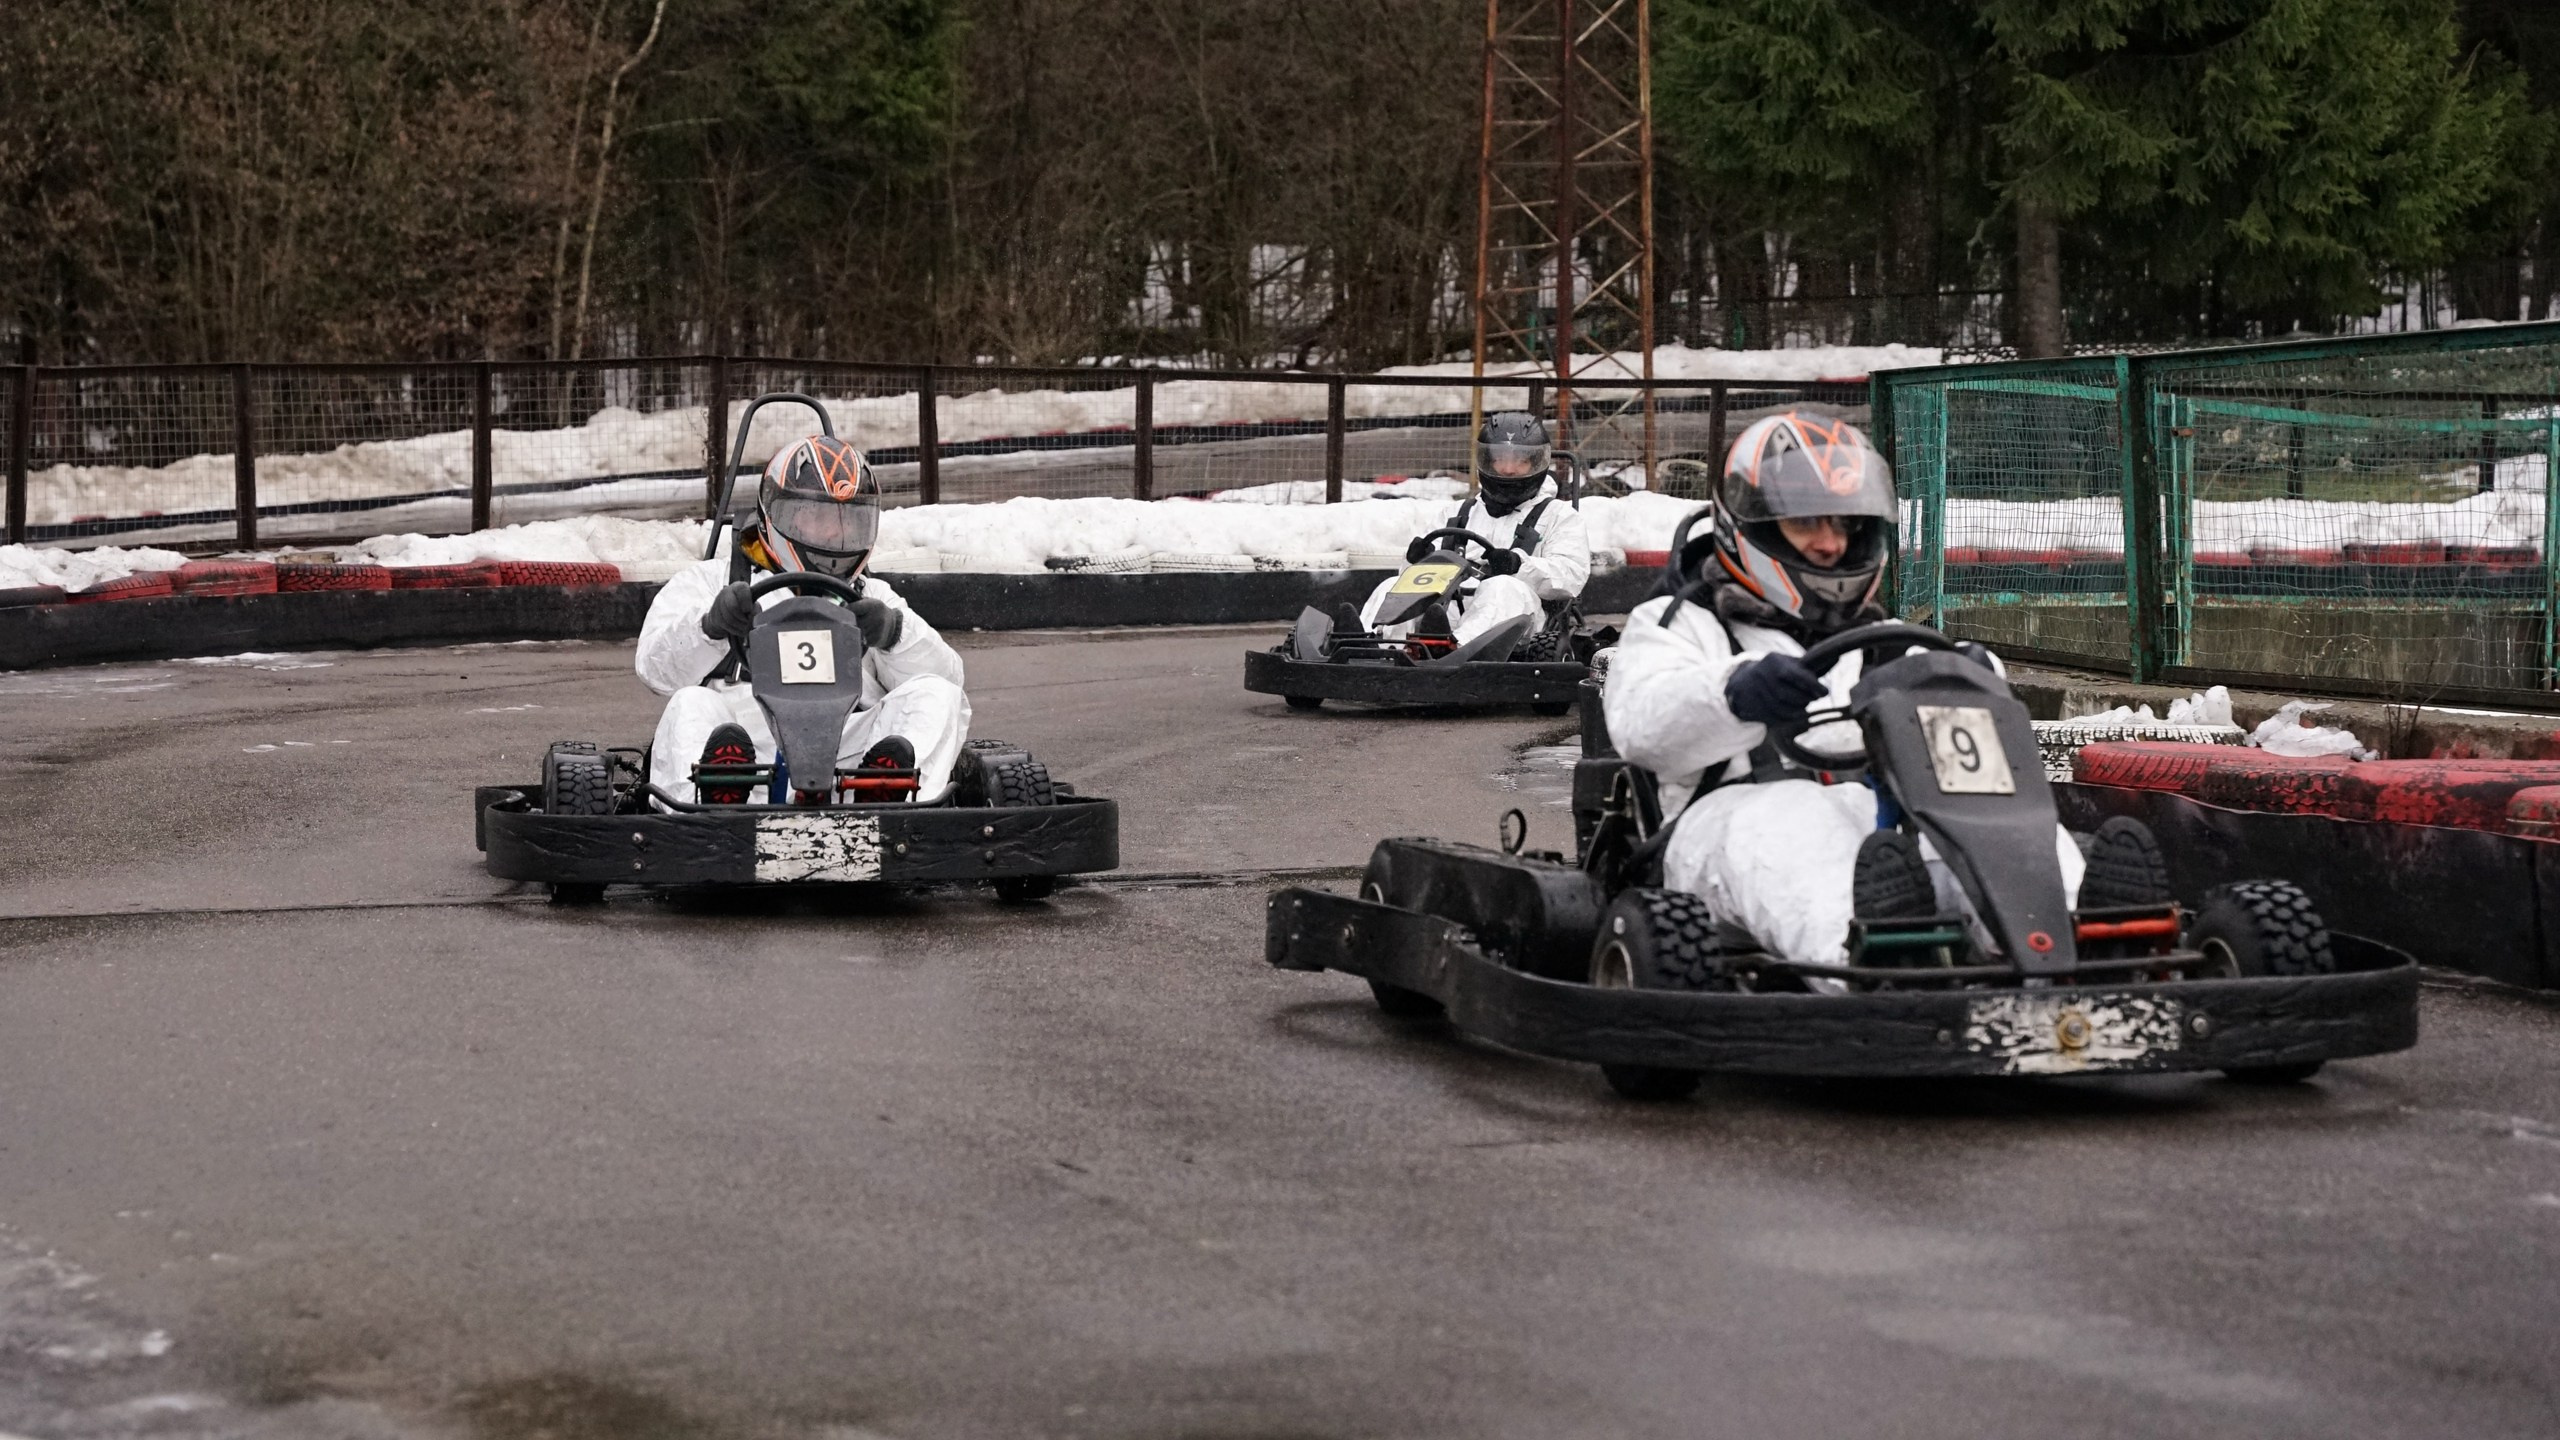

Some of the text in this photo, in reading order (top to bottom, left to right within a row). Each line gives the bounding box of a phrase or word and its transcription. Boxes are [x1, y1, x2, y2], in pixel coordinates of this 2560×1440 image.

[1413, 572, 1437, 586] 6
[797, 642, 817, 670] 3
[1951, 727, 1980, 772] 9
